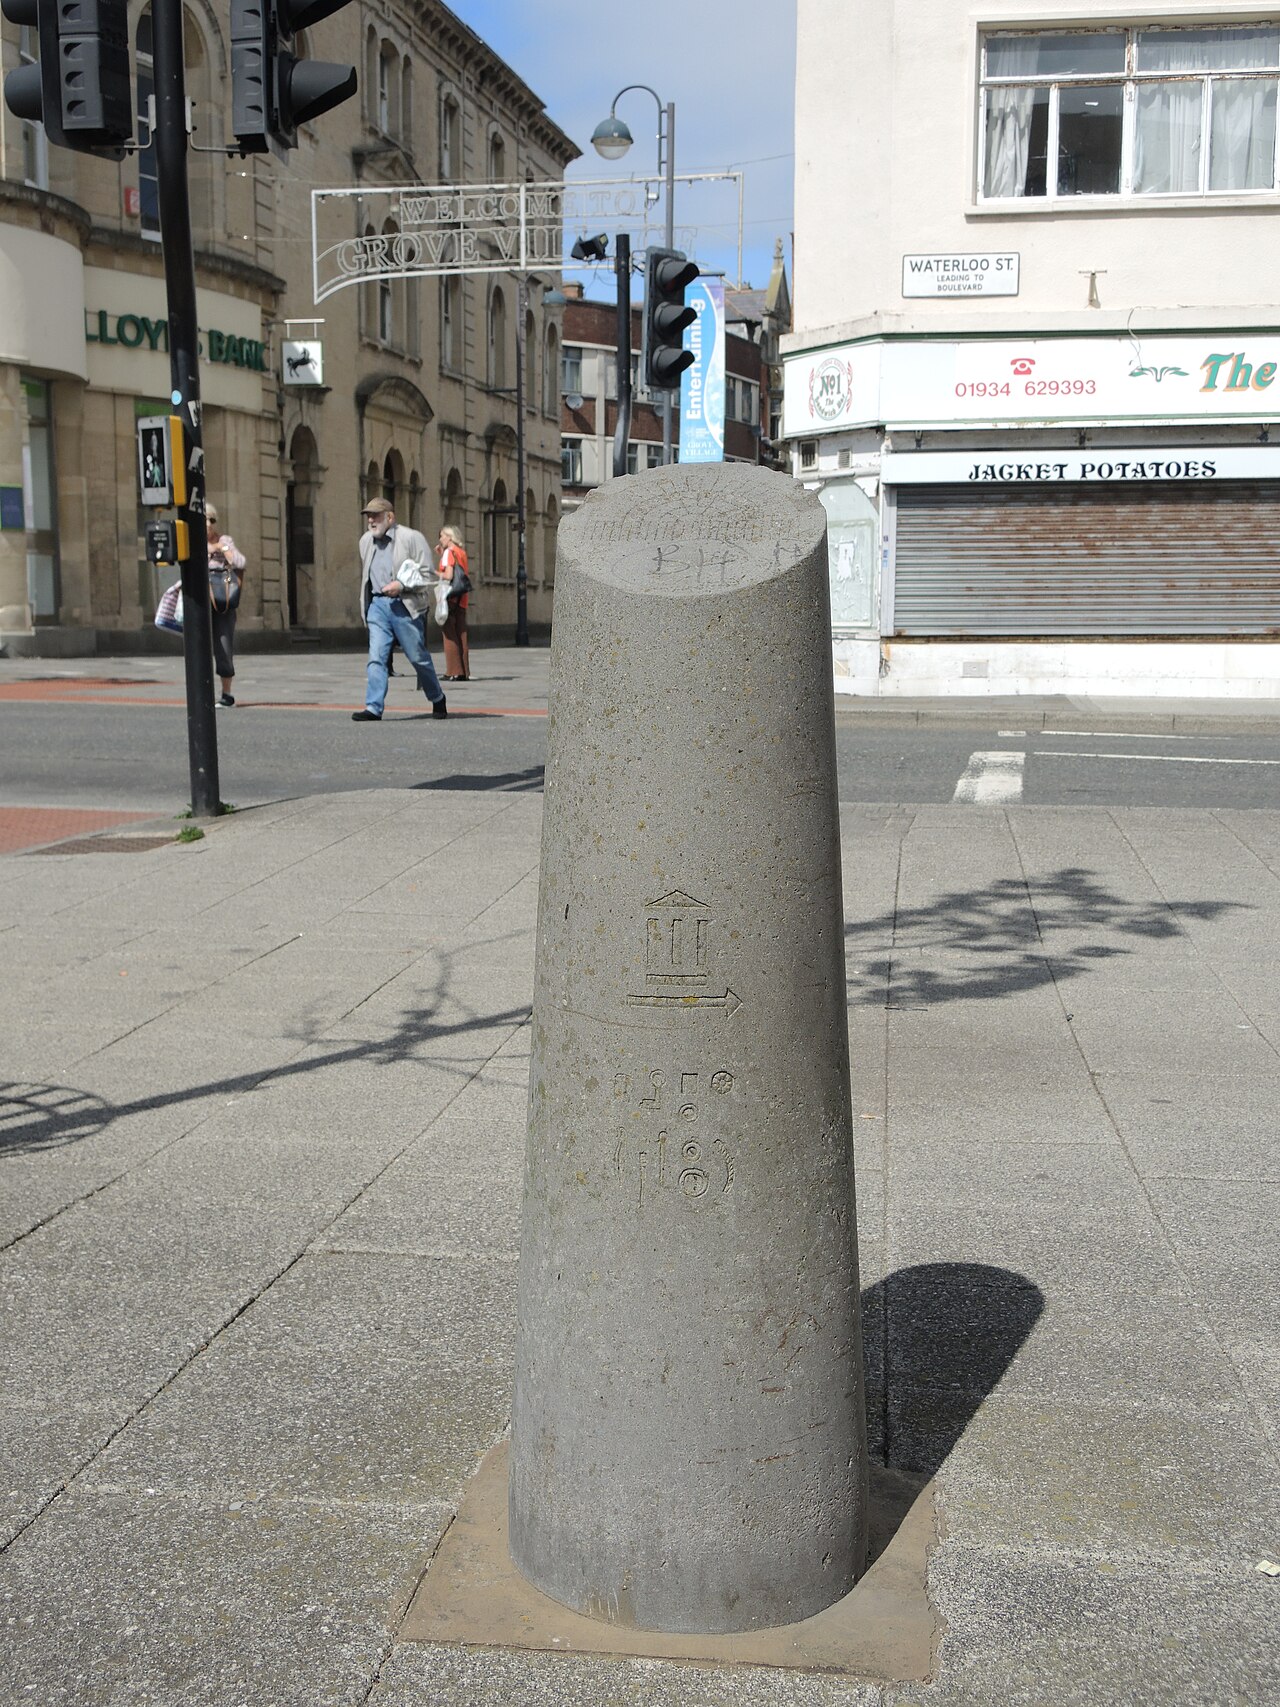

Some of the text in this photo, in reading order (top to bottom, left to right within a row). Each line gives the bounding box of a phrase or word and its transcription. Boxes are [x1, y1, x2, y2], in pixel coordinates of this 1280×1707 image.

[402, 190, 636, 223] WELCOME TO
[337, 231, 481, 278] GROVE
[909, 257, 1014, 273] WATERLOO ST.
[937, 274, 985, 283] LEADING TO
[937, 283, 983, 292] BOULEVARD
[208, 329, 270, 372] BANK
[1199, 352, 1278, 393] The
[955, 380, 1097, 398] 01934 629393
[968, 460, 1217, 481] JACKET POTATOES
